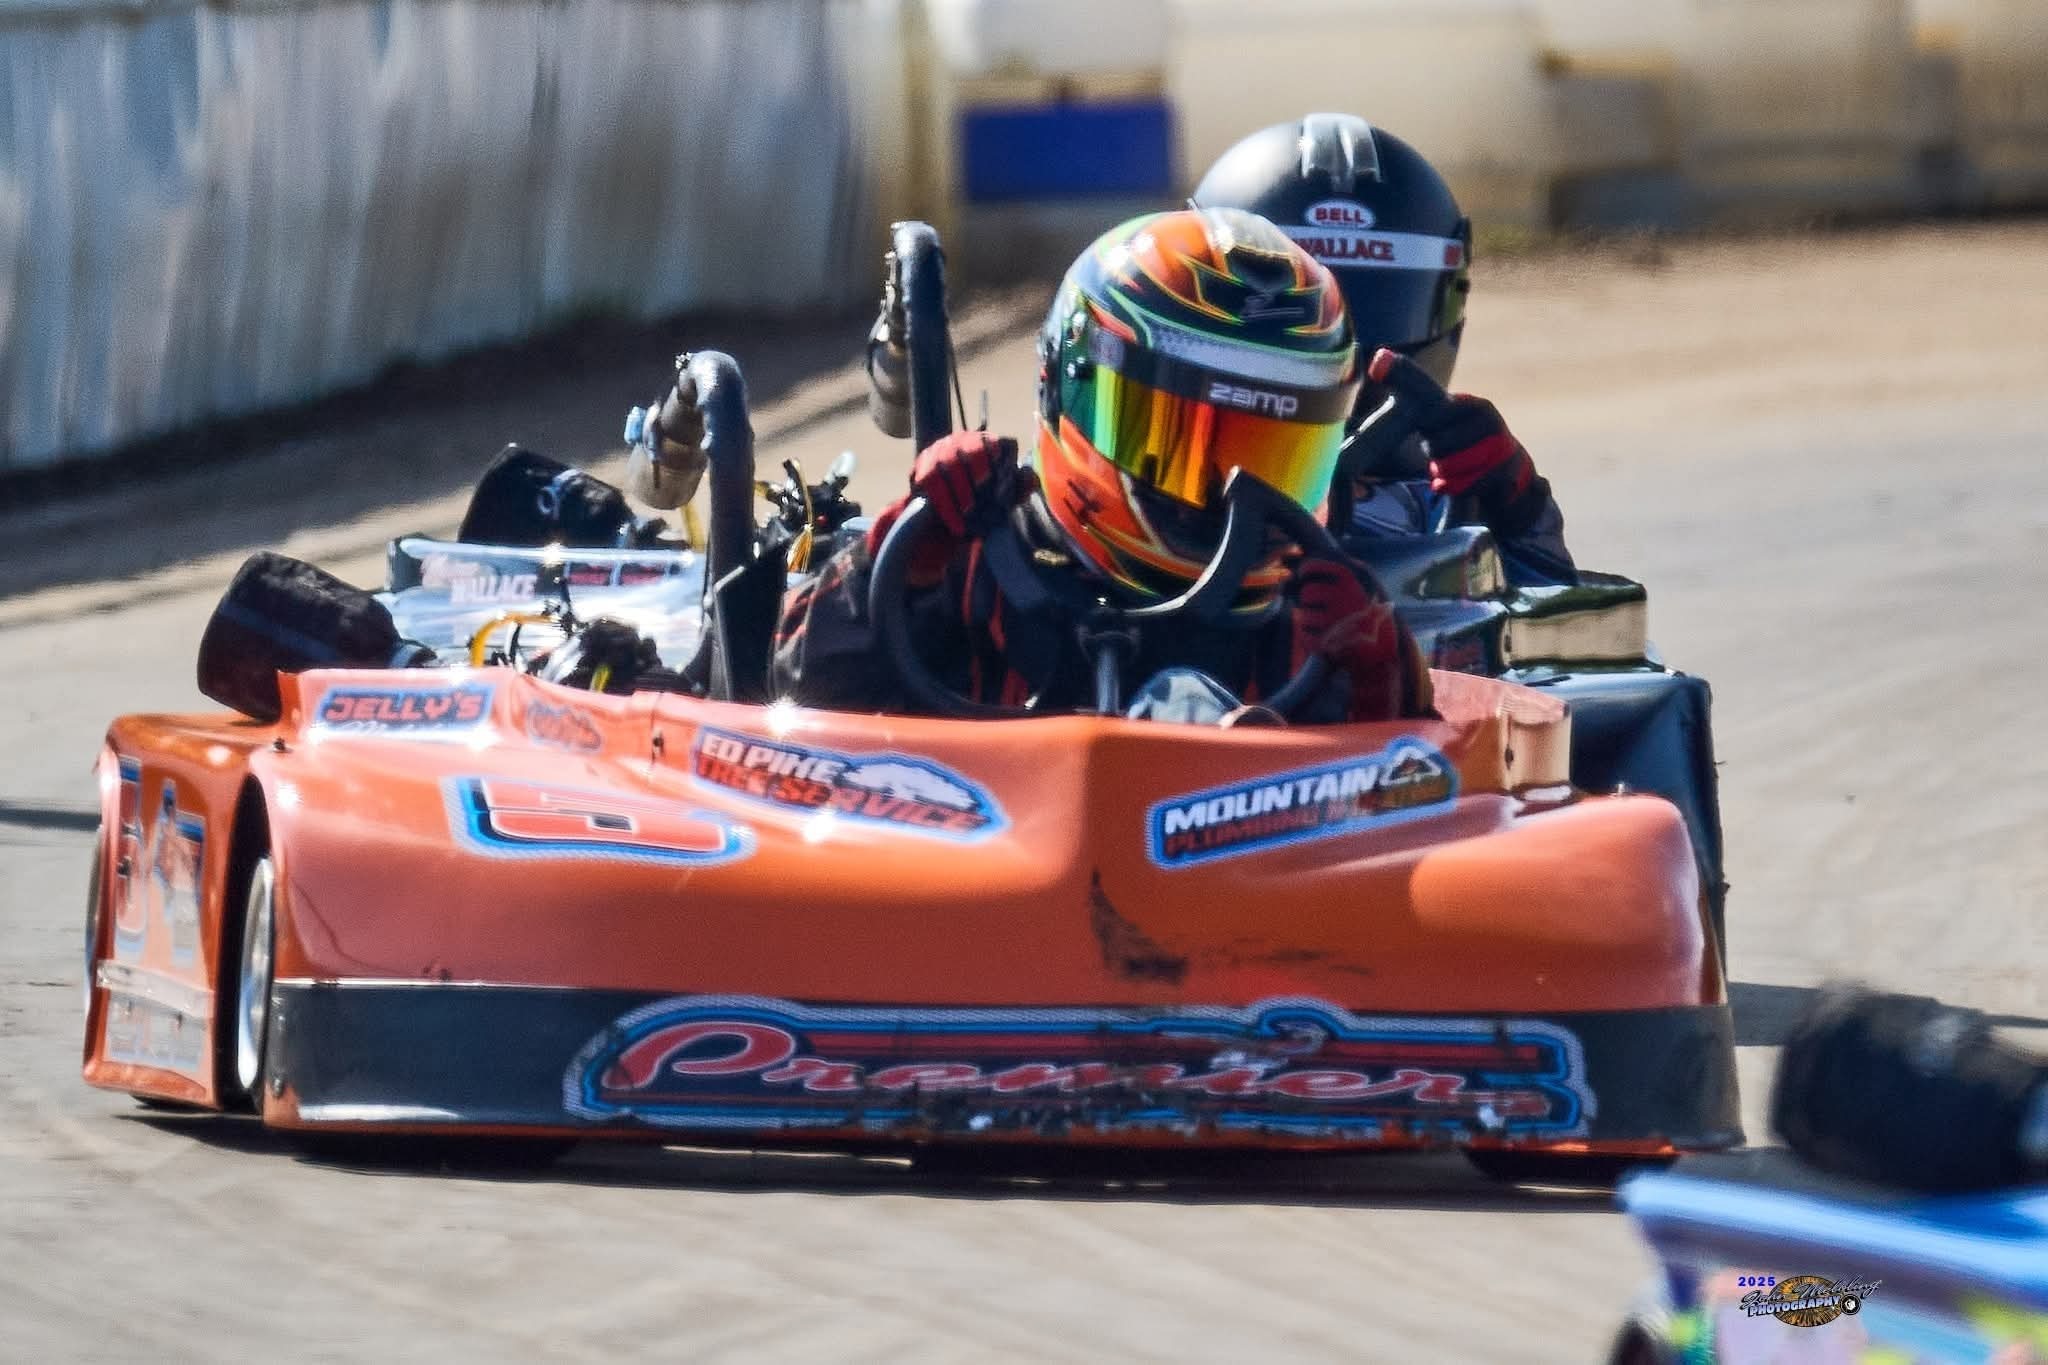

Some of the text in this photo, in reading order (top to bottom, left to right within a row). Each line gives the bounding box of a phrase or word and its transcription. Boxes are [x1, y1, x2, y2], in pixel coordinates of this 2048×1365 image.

[1315, 207, 1365, 223] BELL
[324, 691, 482, 721] JELLY'S
[701, 735, 744, 764] ED
[1164, 765, 1380, 834] MOUNTAIN
